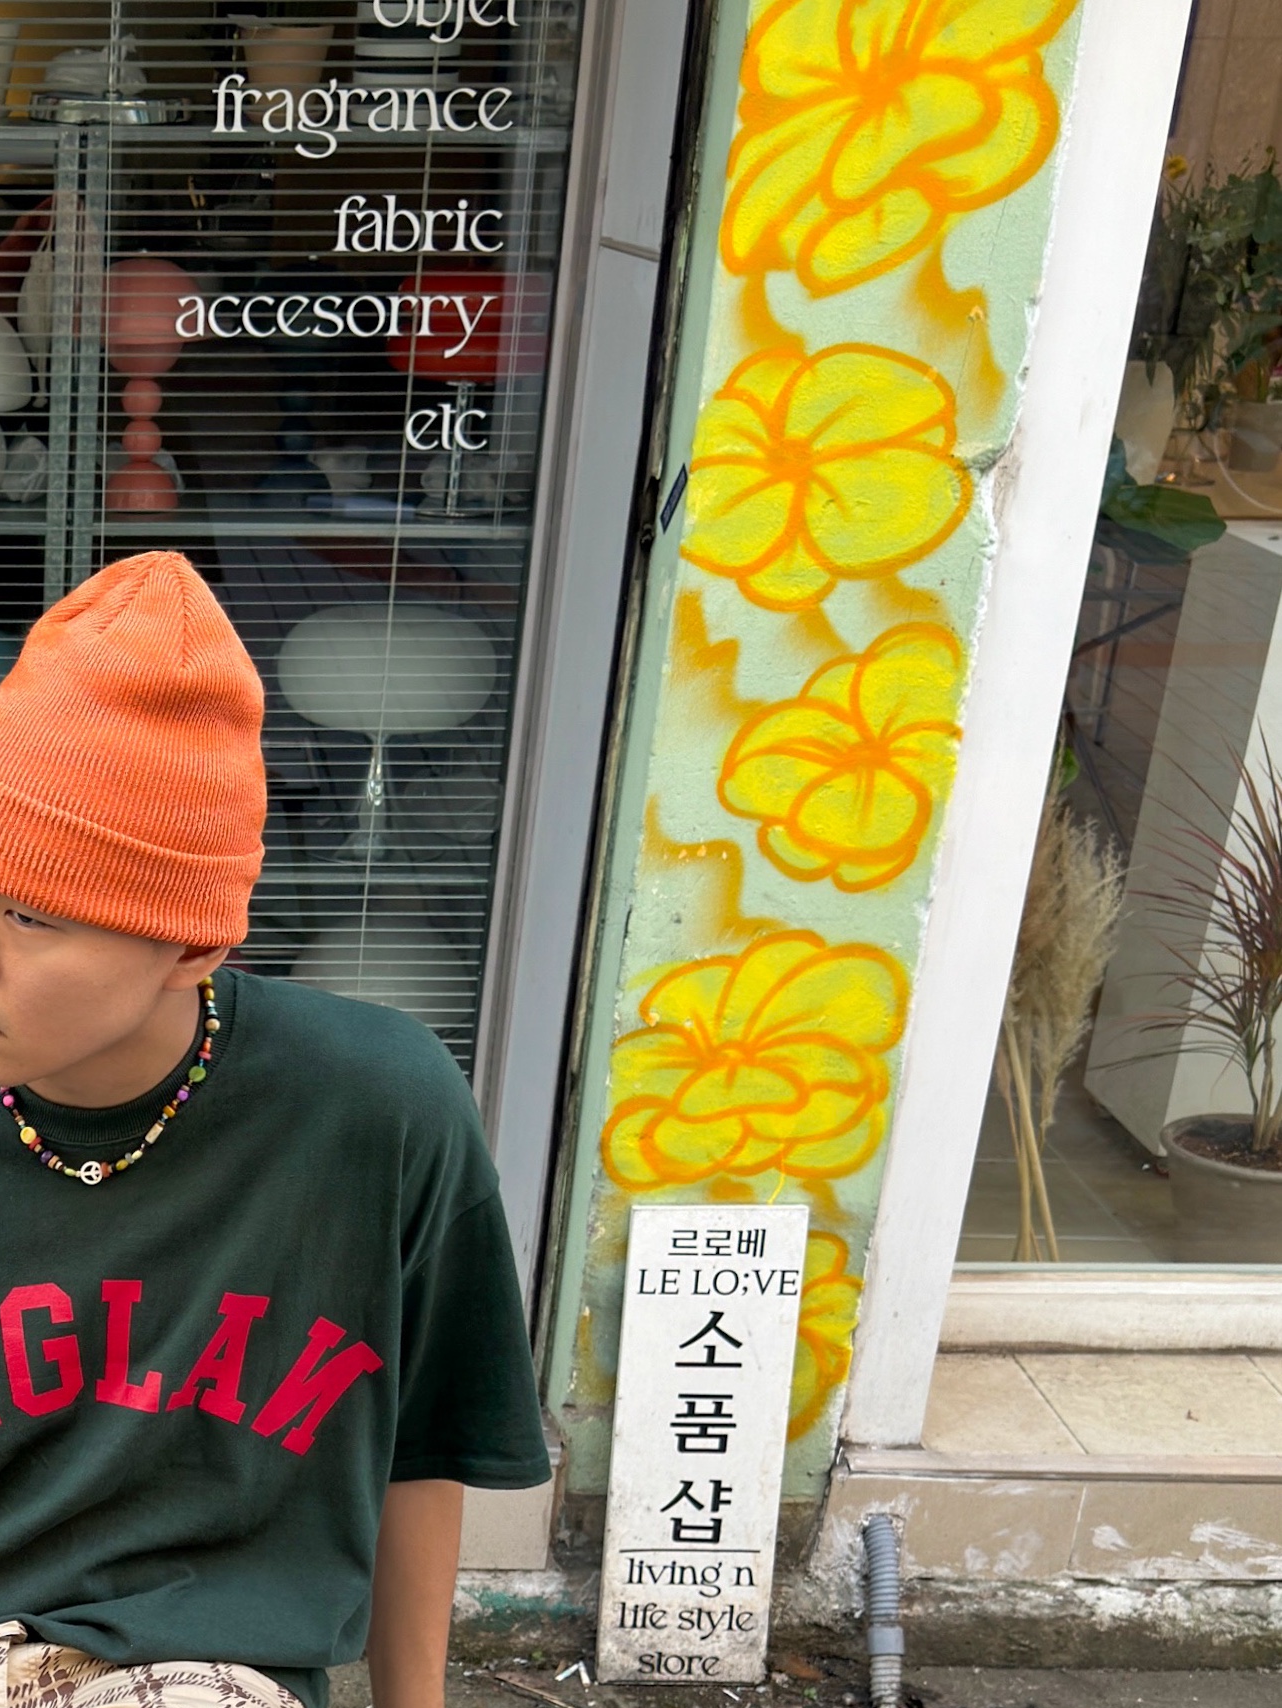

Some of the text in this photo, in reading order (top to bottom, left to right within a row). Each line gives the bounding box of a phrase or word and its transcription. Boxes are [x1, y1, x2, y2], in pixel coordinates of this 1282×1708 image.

[212, 74, 514, 158] fragrance
[334, 195, 504, 252] fabric
[175, 296, 498, 358] accesorry
[405, 403, 487, 450] etc
[668, 1228, 766, 1258] 르로베
[637, 1268, 800, 1296] LE LO;VE
[626, 1558, 757, 1598] living n
[617, 1601, 755, 1640] life style
[638, 1651, 722, 1676] store
